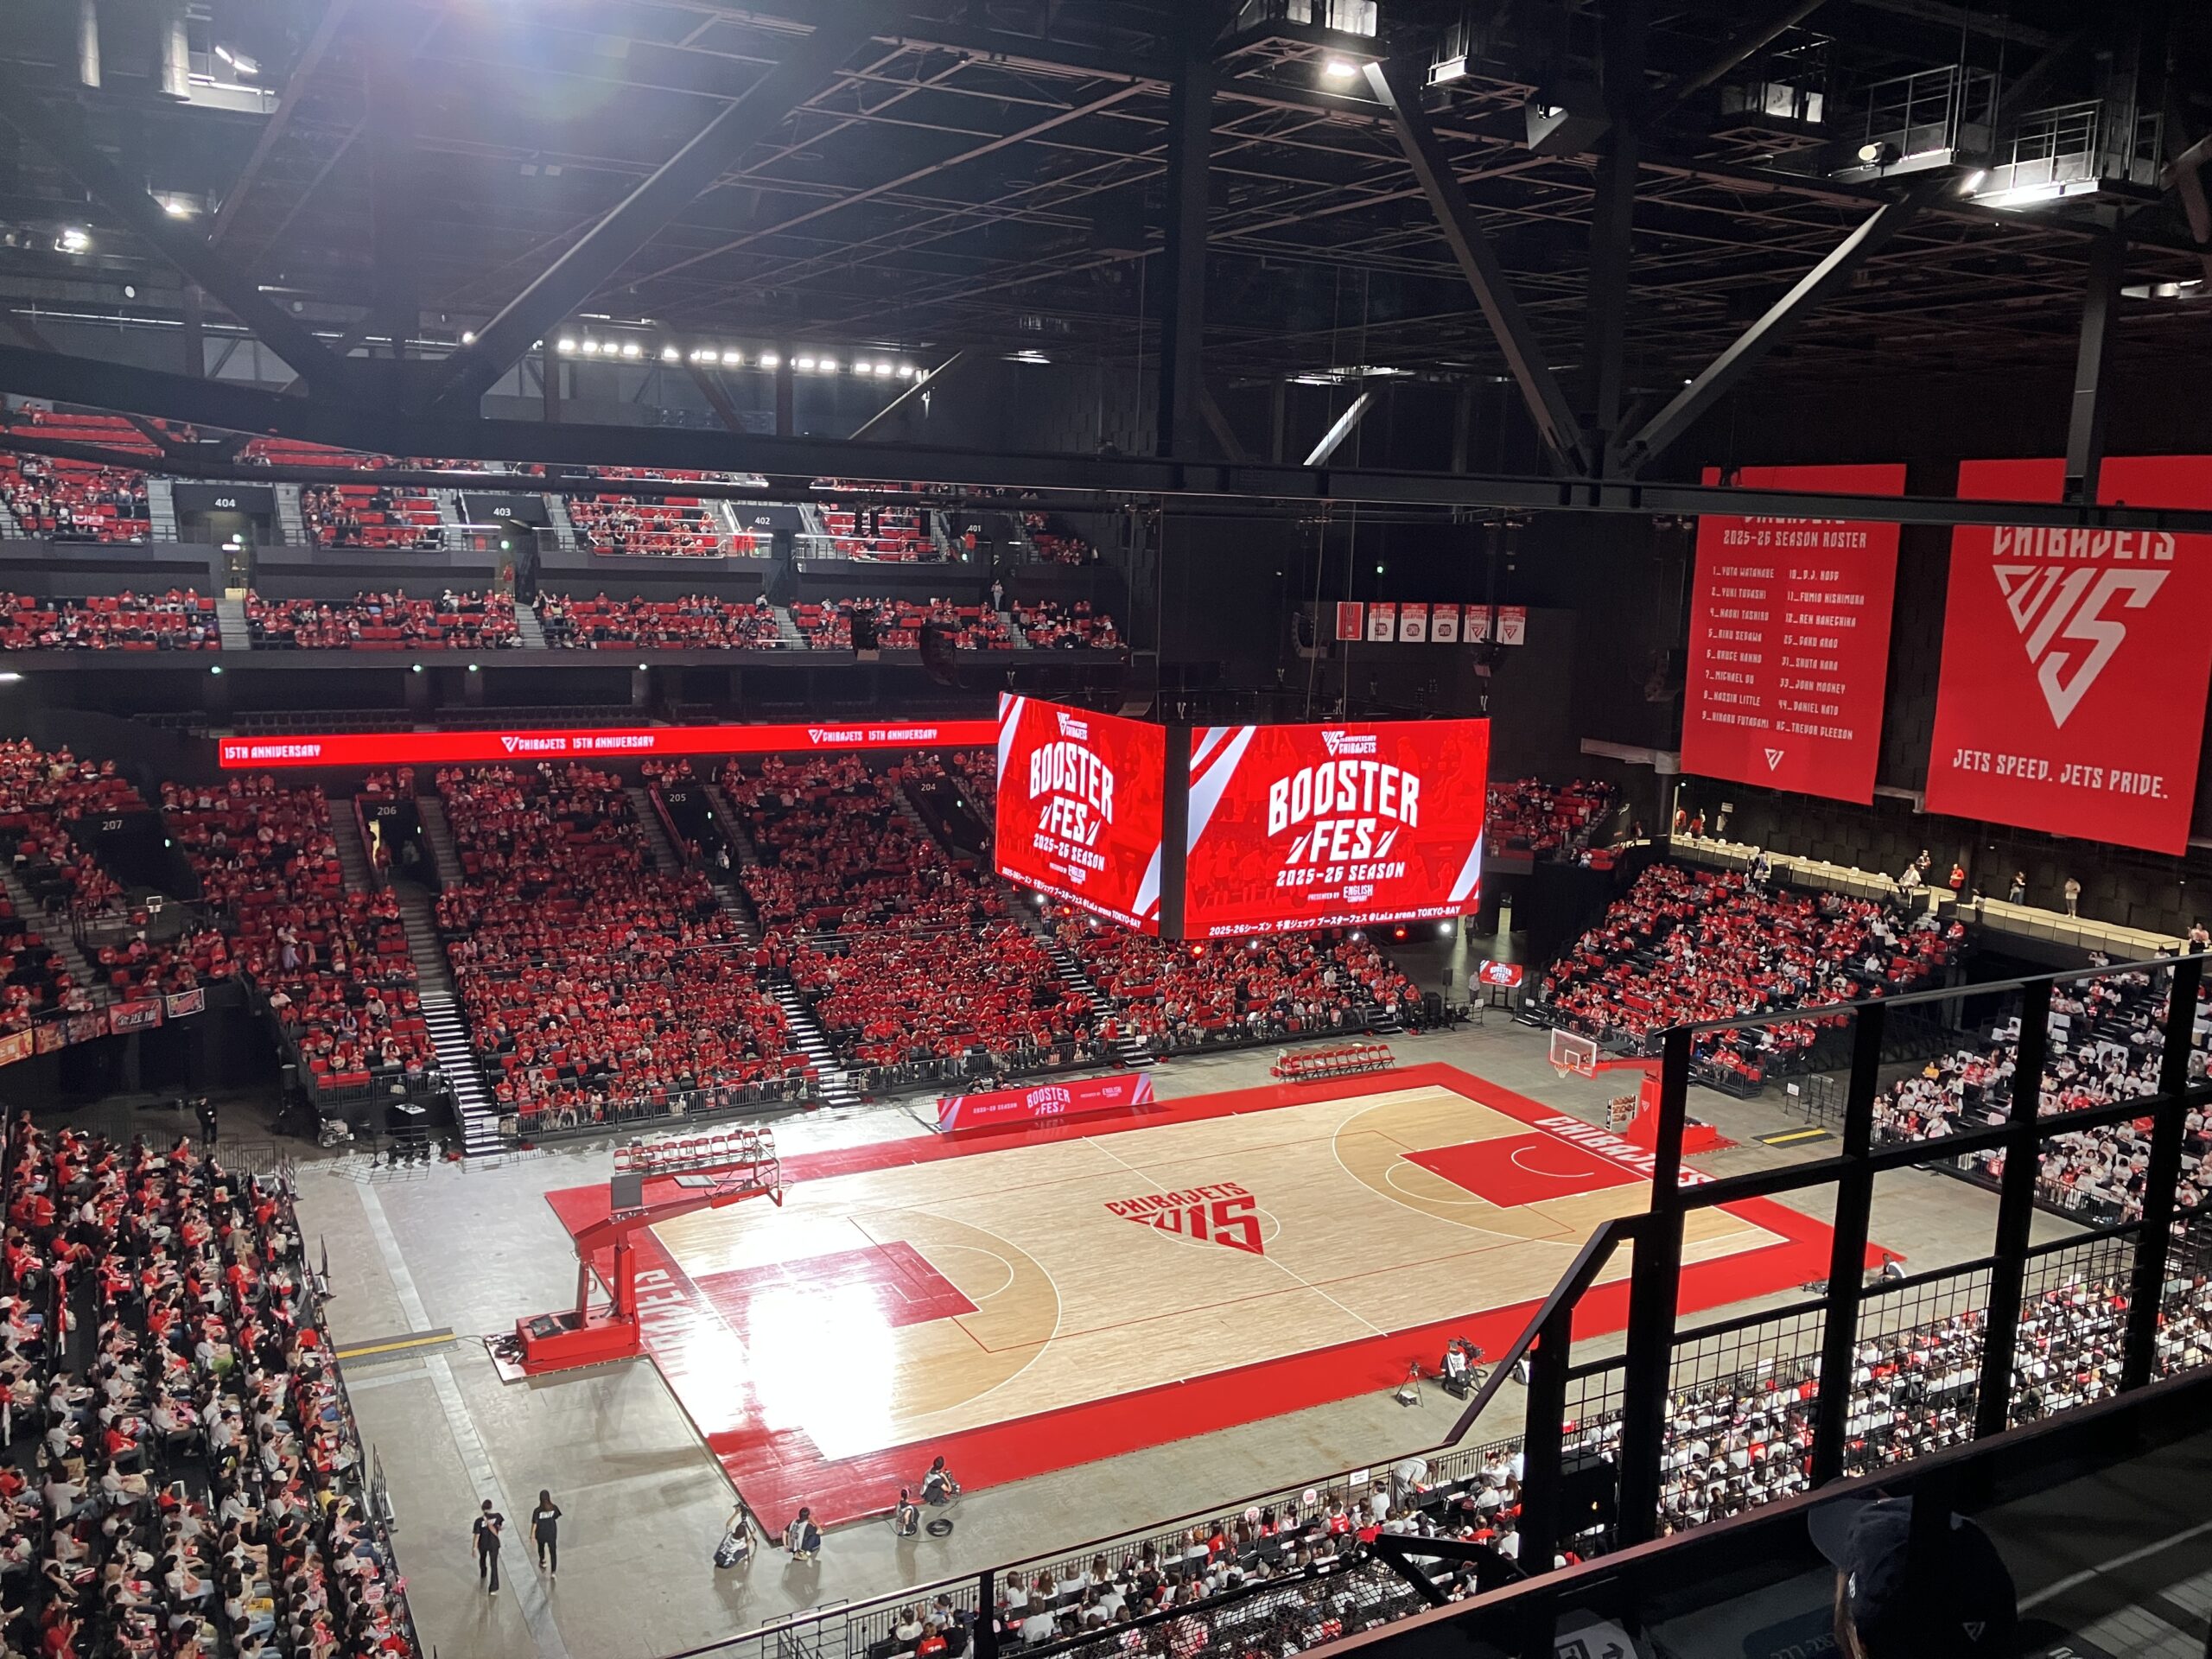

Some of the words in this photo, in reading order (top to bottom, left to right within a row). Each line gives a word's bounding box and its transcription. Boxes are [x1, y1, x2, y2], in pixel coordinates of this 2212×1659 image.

[215, 498, 236, 508] 404
[493, 507, 512, 517] 403
[754, 517, 771, 525] 402
[968, 524, 982, 533] 401
[1723, 530, 1770, 545] 2025-26
[1775, 531, 1818, 547] SEASON
[1823, 532, 1866, 548] ROSTER
[1740, 567, 1774, 578] WATANABE
[1825, 593, 1864, 605] NISHIMURA
[1742, 609, 1769, 620] TASHIRO
[1816, 682, 1845, 695] MOONEY
[1739, 694, 1760, 707] LITTLE
[823, 731, 863, 742] CHIBAJETS
[868, 730, 885, 741] 15TH
[887, 728, 938, 741] ANNIVERSARY
[1820, 726, 1853, 740] GLEESON
[518, 738, 566, 751] CHIBAJETS
[573, 737, 594, 749] 15TH
[595, 734, 654, 749] ANNIVERSARY
[1338, 742, 1376, 754] CHIBAJETS
[225, 747, 249, 760] 15TH
[251, 745, 321, 759] ANNIVERSARY
[1954, 748, 1991, 772] JETS
[1996, 754, 2053, 783] SPEED.
[2061, 764, 2104, 789] JETS
[2109, 769, 2169, 799] PRIDE.
[920, 782, 937, 791] 204
[1030, 741, 1113, 824] BOOSTER
[669, 793, 687, 803] 205
[1268, 760, 1420, 837] BOOSTER
[377, 805, 397, 816] 206
[102, 818, 123, 830] 207
[1050, 796, 1088, 844] FES
[1310, 817, 1376, 862] FES
[1033, 834, 1069, 858] 2025-26
[1071, 843, 1105, 871] SEASON
[1276, 867, 1344, 887] 2025-26
[1348, 862, 1405, 881] SEASON
[1344, 885, 1373, 899] ENGLISH
[1111, 909, 1141, 928] TOKYO-BAY
[1209, 921, 1272, 937] 2025-26シーズン
[1276, 918, 1315, 931] 千葉ジェッツ
[1318, 915, 1367, 926] ブースターフェス
[1370, 912, 1393, 921] @LaLa
[1395, 911, 1415, 919] arena
[1418, 906, 1460, 918] TOKYO-BAY
[1026, 1087, 1071, 1109] BOOSTER
[1040, 1103, 1059, 1116] FES
[1104, 1182, 1249, 1217] CHIBAJETS
